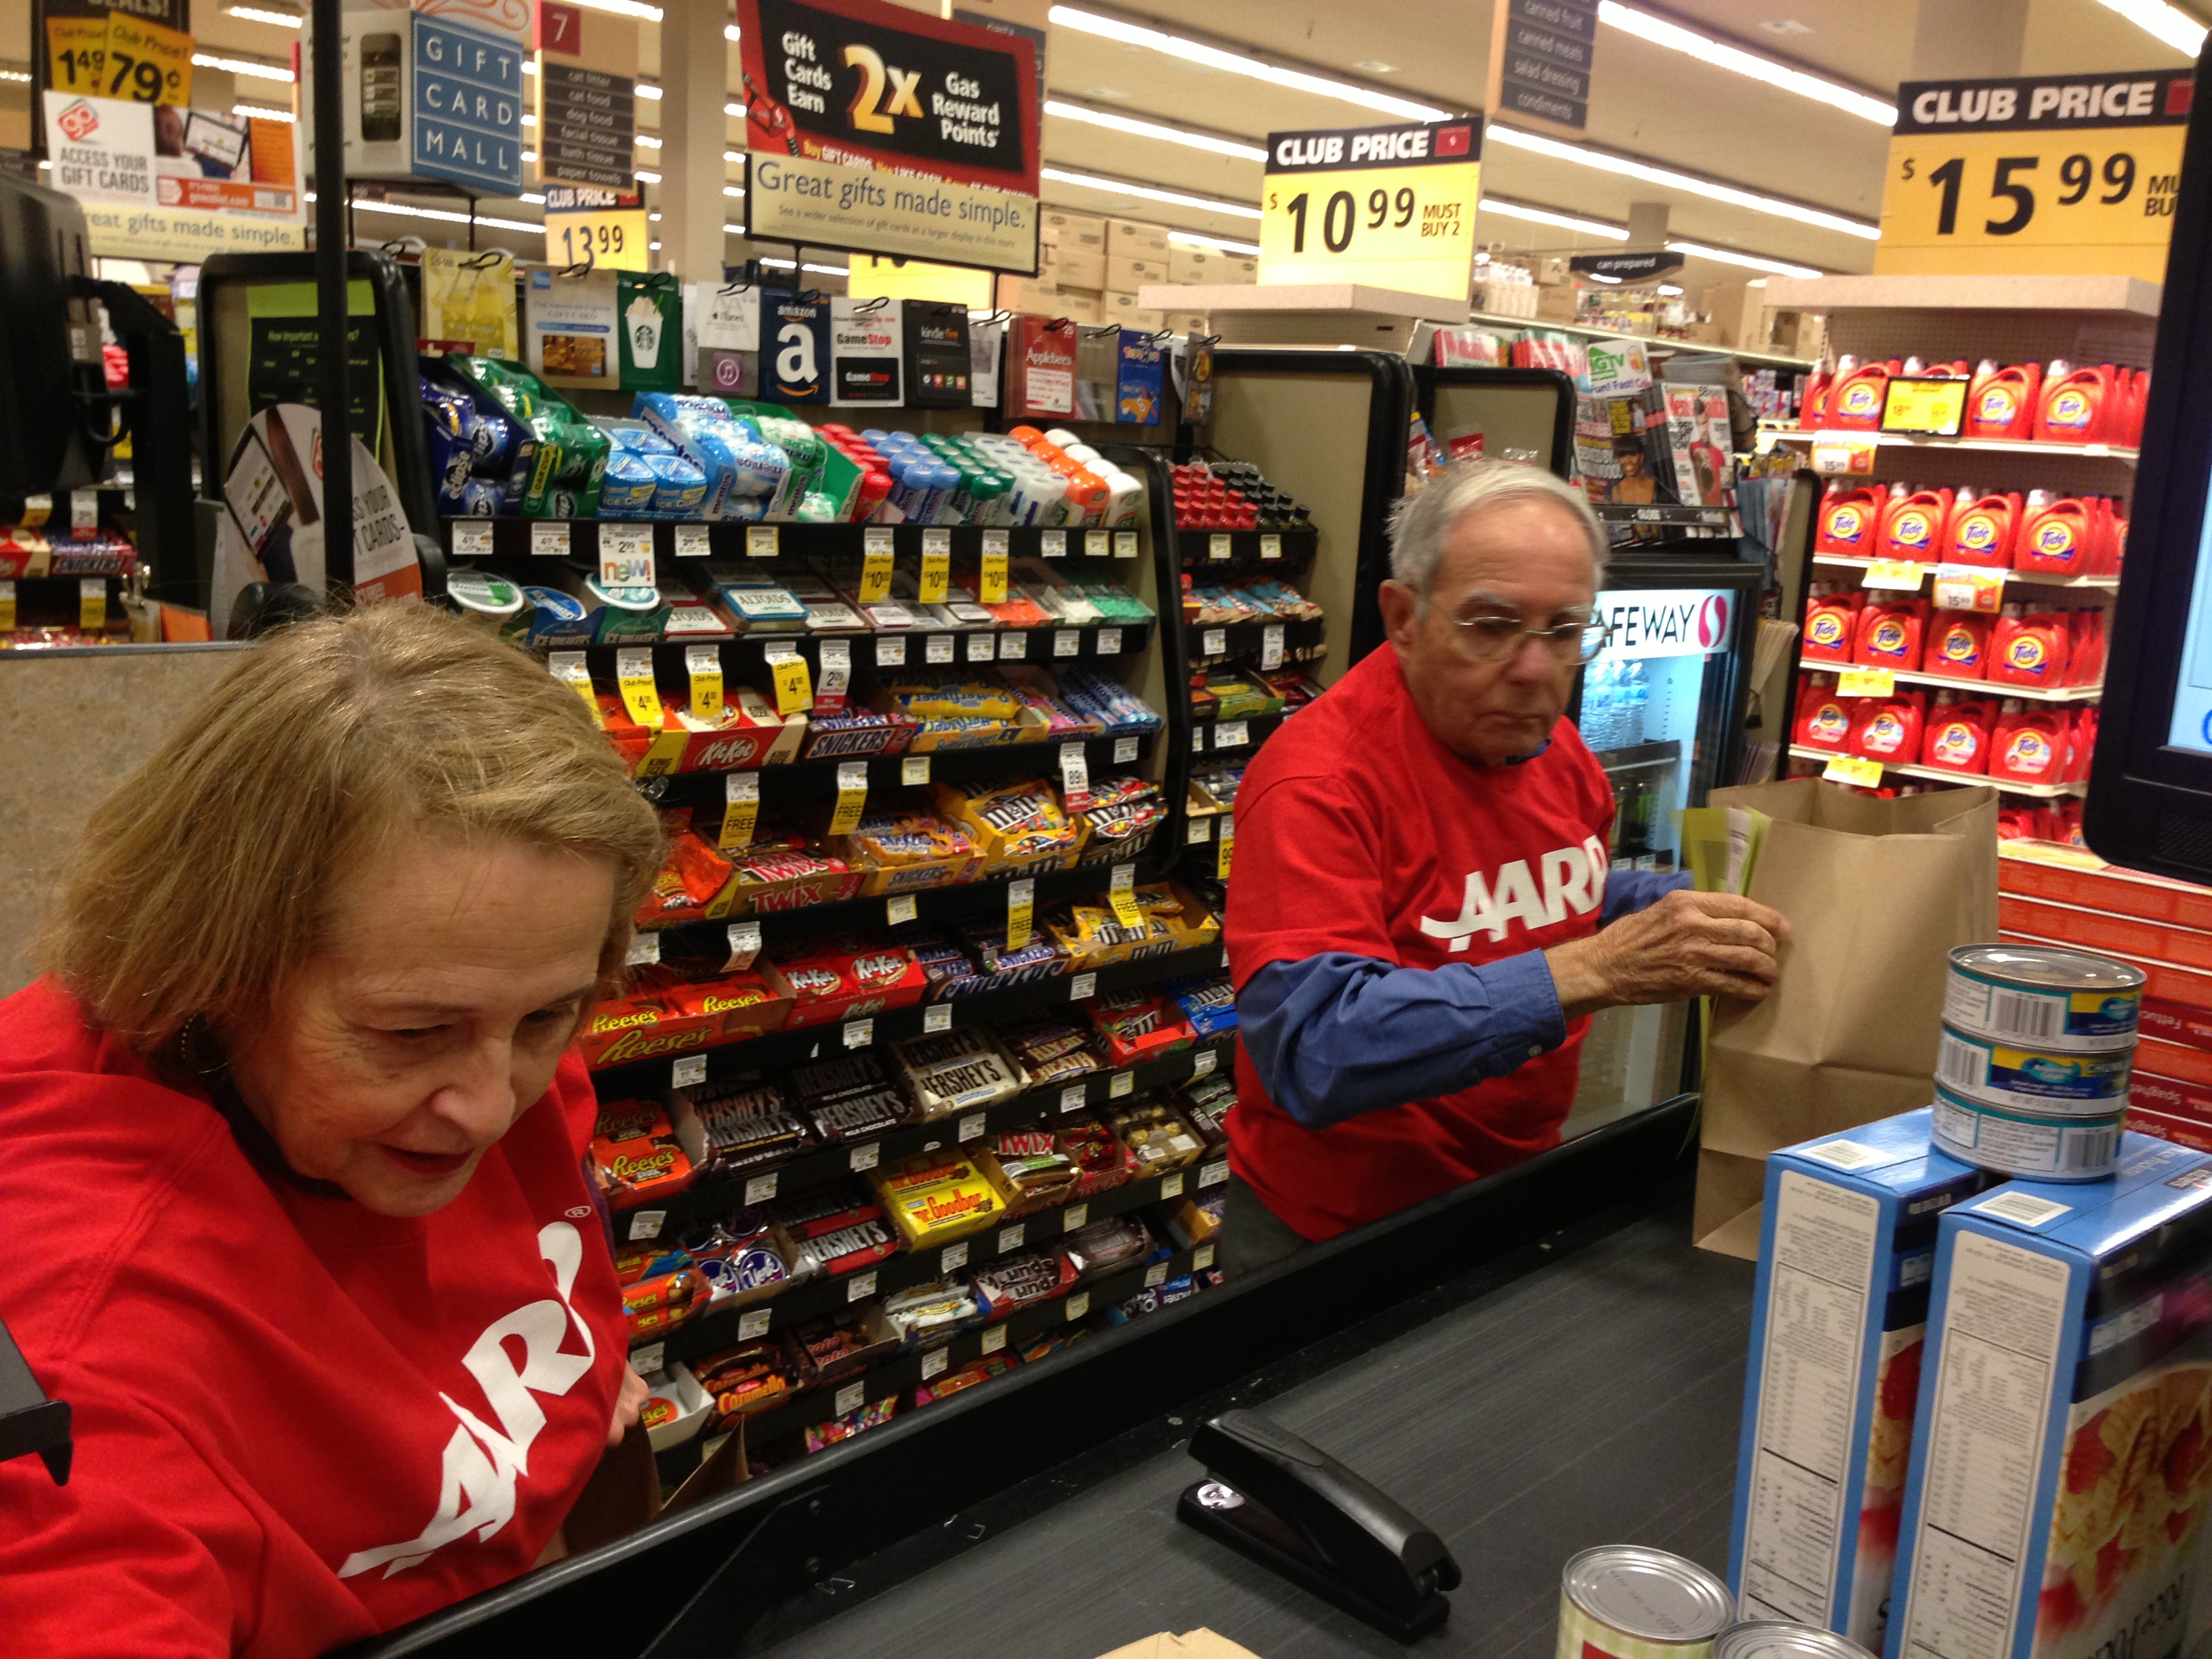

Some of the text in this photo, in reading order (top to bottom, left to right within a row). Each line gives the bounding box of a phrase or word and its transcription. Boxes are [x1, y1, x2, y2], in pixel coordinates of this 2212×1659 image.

[550, 13, 568, 42] 7
[783, 31, 817, 62] Gift
[784, 57, 833, 91] Cards
[945, 72, 980, 99] Gas
[426, 83, 512, 125] CARD
[787, 84, 825, 114] Earn
[1912, 81, 2157, 125] CLUB PRICE
[566, 107, 613, 127] dog food
[931, 94, 1000, 125] Reward
[426, 129, 509, 169] MALL
[821, 145, 842, 166] GIFT
[1275, 129, 1431, 166] CLUB PRICE
[60, 146, 148, 171] ACCESS YOUR
[61, 167, 149, 194] GIFT CARDS
[2146, 174, 2181, 195] MU
[547, 187, 617, 209] CLUB PRICE
[757, 161, 833, 199] Great
[839, 178, 886, 209] gifts
[894, 188, 951, 218] made
[958, 197, 1025, 232] simple.
[779, 205, 795, 217] See
[803, 209, 826, 222] wider
[828, 213, 865, 228] selection
[1422, 203, 1461, 220] MUST
[2144, 199, 2177, 218] BU
[85, 209, 121, 231] reat
[127, 211, 167, 238] gifts
[173, 217, 225, 239] made
[230, 223, 296, 248] simple.
[1421, 221, 1460, 237] BUY 2
[719, 311, 744, 323] iTunes
[777, 305, 817, 318] amazon
[920, 325, 945, 339] kindle
[776, 323, 819, 384] a
[1849, 391, 1871, 408] Tide
[1982, 393, 2006, 411] Tide
[2057, 399, 2081, 415] Tide
[1834, 516, 1856, 531] Tide
[1899, 521, 1923, 537] Tide
[1965, 525, 1989, 541] Tide
[2040, 530, 2064, 548] Tide
[56, 556, 123, 574] SNICKERS
[604, 560, 651, 583] new!
[739, 594, 792, 607] ALTOIDS
[1815, 621, 1837, 636] Tide
[1877, 628, 1900, 643] Tide
[1947, 636, 1971, 651] Tide
[2013, 644, 2039, 661] Tide
[1818, 708, 1839, 723] Tide
[1875, 718, 1895, 735] Tide
[810, 729, 893, 758] SNICKERS
[1946, 729, 1967, 745] Tide
[2014, 738, 2039, 754] Tide
[649, 757, 673, 768] KING
[697, 740, 756, 767] KitKat
[838, 805, 863, 818] FREE
[725, 817, 755, 831] FREE
[1420, 834, 1608, 954] AARP
[596, 1025, 713, 1066] Reese's
[811, 1090, 907, 1132] HERSHEY'S
[613, 1150, 675, 1176] Reese's
